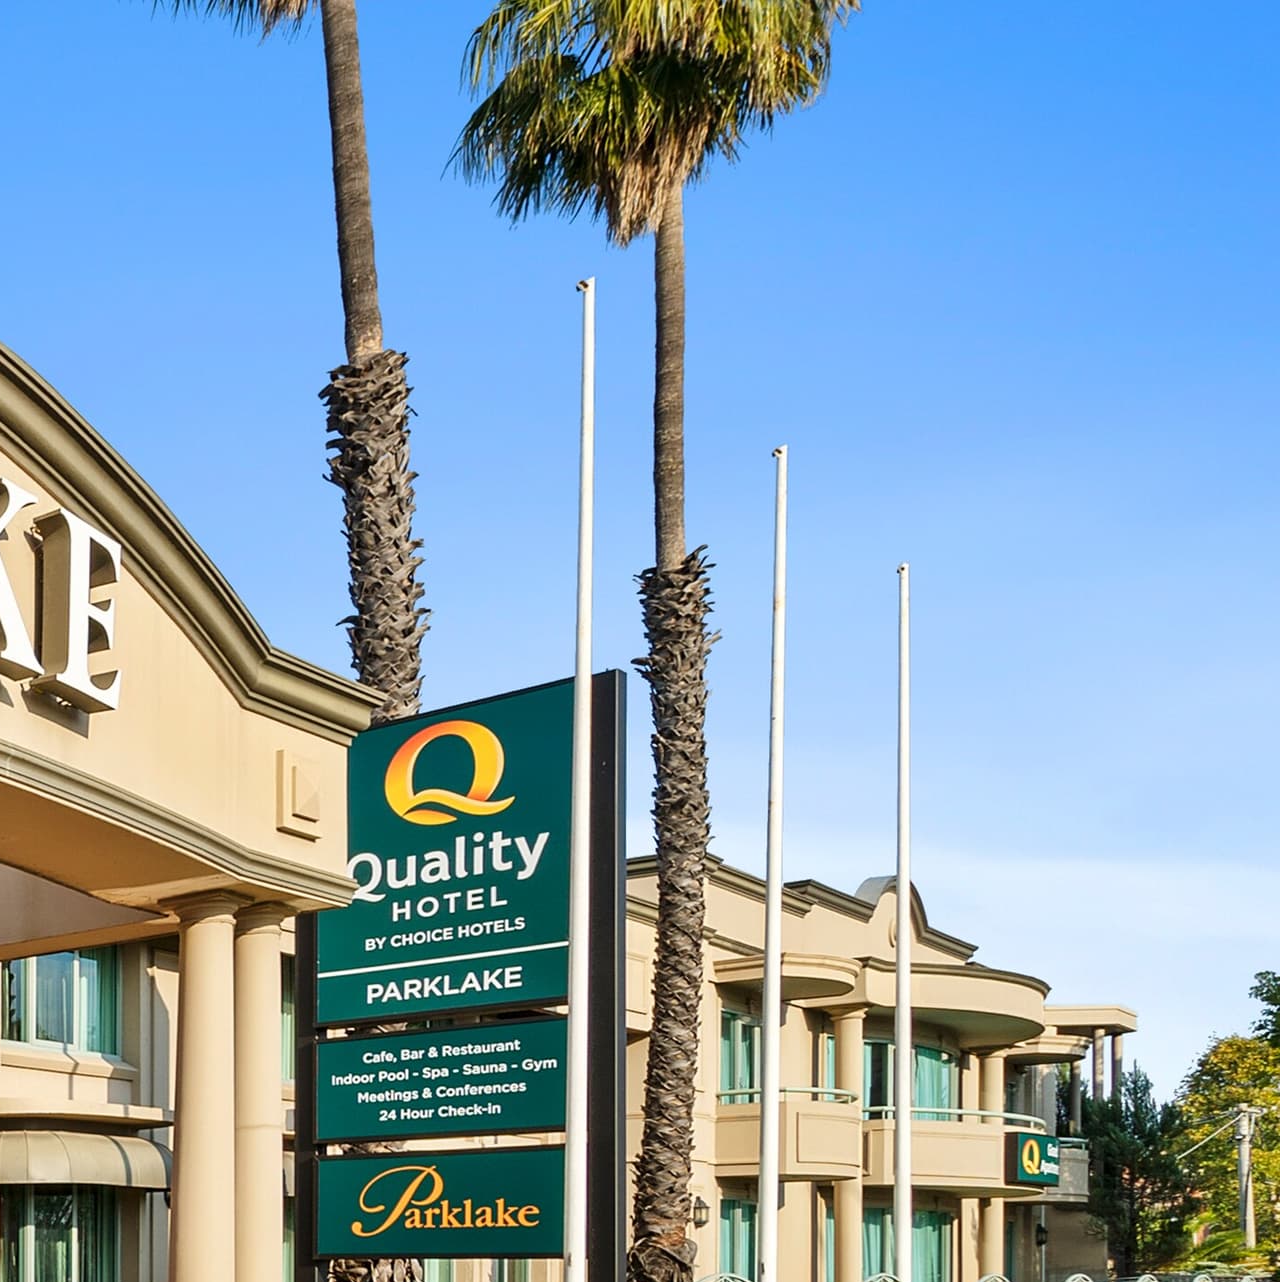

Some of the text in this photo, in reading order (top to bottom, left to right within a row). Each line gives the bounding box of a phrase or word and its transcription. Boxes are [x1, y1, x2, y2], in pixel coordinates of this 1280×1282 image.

[346, 831, 550, 902] Quality
[391, 886, 508, 922] HOTEL
[365, 917, 526, 951] BY CHOICE HOTELS
[366, 966, 523, 1004] PARKLAKE
[362, 1039, 521, 1064] Cafe, Bar & Restaurant
[331, 1073, 375, 1086] Indoor
[378, 1068, 409, 1082] Pool
[422, 1067, 449, 1080] Spa
[462, 1062, 507, 1076] Sauna
[522, 1057, 557, 1073] Gym
[357, 1081, 527, 1104] Meetings & Conferences
[379, 1103, 501, 1121] 24 Hour Check-in
[351, 1165, 540, 1238] Parklake
